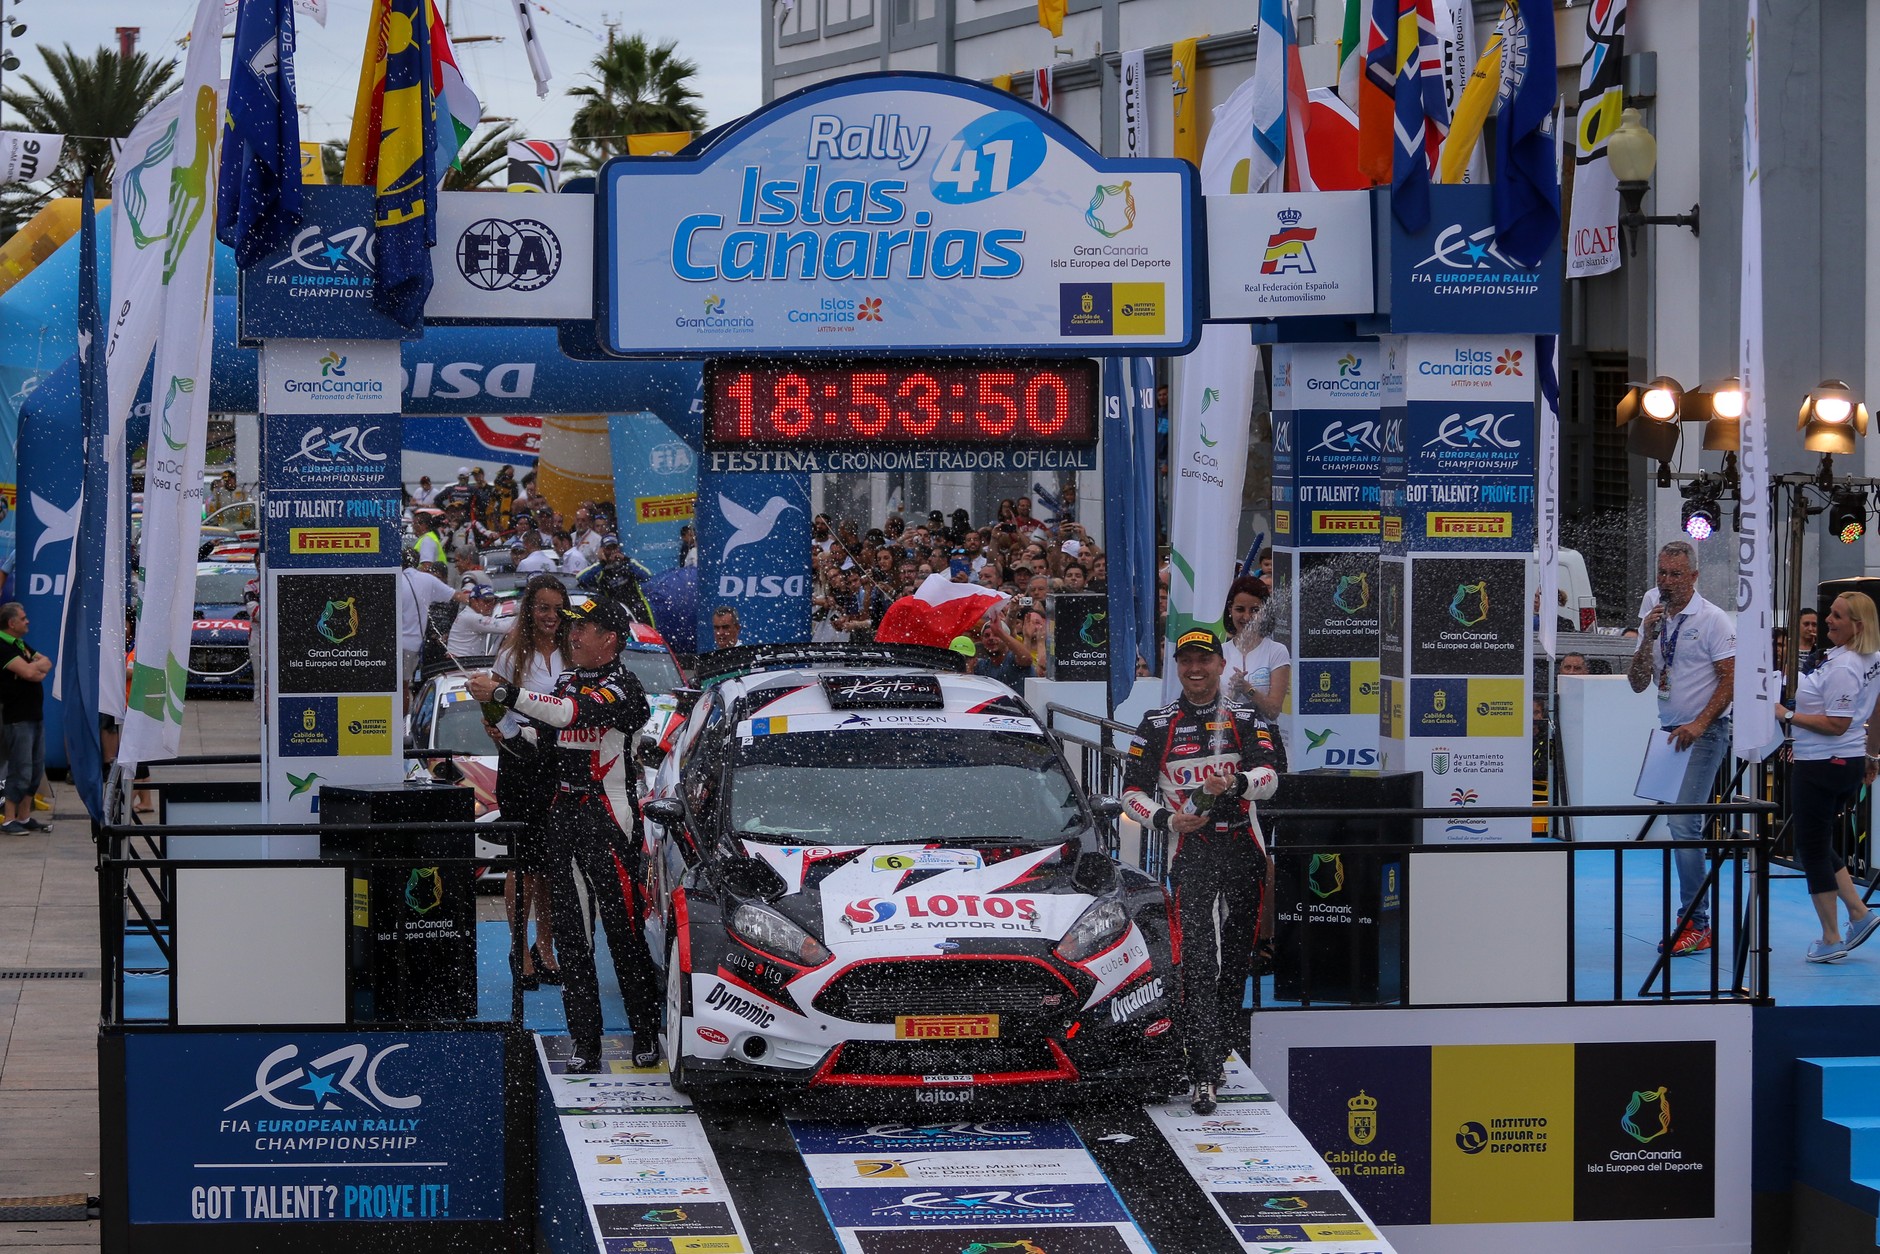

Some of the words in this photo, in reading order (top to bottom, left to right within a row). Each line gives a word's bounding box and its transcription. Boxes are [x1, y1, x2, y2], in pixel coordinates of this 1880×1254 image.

[808, 113, 931, 170] Rally
[932, 139, 1014, 193] 41
[737, 163, 907, 226] Islas
[671, 210, 1026, 281] Canarias
[1050, 258, 1067, 270] Isla
[1069, 258, 1110, 270] Europea
[1113, 258, 1129, 270] del
[1131, 258, 1171, 270] Deporte
[266, 275, 287, 285] FIA
[291, 276, 360, 286] EUROPEAN
[1411, 273, 1431, 283] FIA
[1435, 273, 1500, 283] EUROPEAN
[1503, 273, 1540, 283] RALLY
[1244, 283, 1260, 292] Real
[1262, 281, 1304, 292] Federación
[1305, 281, 1339, 292] Española
[1434, 285, 1538, 295] CHAMPIONSHIP
[820, 297, 855, 310] Islas
[1258, 293, 1267, 302] de
[1269, 293, 1326, 302] Automovilismo
[676, 315, 754, 328] GranCanaria
[788, 309, 855, 323] Canarias
[1455, 348, 1492, 362] Islas
[1419, 361, 1492, 376] Canarias
[284, 379, 383, 393] GranCanaria
[311, 393, 344, 401] Patronato
[346, 393, 354, 401] de
[356, 393, 383, 401] Turismo
[727, 373, 1069, 437] 18:53:50
[1422, 413, 1521, 449] ERC
[284, 426, 387, 462] ERC
[711, 451, 819, 472] FESTINA
[828, 450, 1005, 470] CRONOMETRADOR
[1012, 450, 1088, 468] OFICIAL
[1420, 451, 1436, 459] FIA
[1439, 451, 1489, 459] EUROPEAN
[1491, 451, 1519, 459] RALLY
[282, 465, 298, 473] FIA
[302, 465, 354, 473] EUROPEAN
[356, 465, 386, 473] RALLY
[1438, 460, 1518, 468] CHAMPIONSHIP
[300, 474, 385, 482] CHAMPIONSHIP
[1407, 485, 1429, 502] GOT
[1432, 485, 1479, 502] TALENT?
[1481, 485, 1516, 502] PROVE
[1518, 485, 1534, 502] IT!
[268, 500, 293, 518] GOT
[294, 500, 344, 518] TALENT?
[346, 500, 382, 518] PROVE
[1435, 516, 1504, 533] PIRELLI
[299, 532, 371, 549] PIRELLI
[1422, 641, 1435, 651] Isla
[1437, 641, 1467, 651] Europea
[1470, 641, 1482, 651] del
[1484, 641, 1515, 651] Deporte
[290, 658, 303, 668] Isla
[305, 658, 338, 668] Europea
[339, 658, 352, 668] del
[354, 658, 386, 668] Deporte
[538, 695, 563, 706] LOTOS
[879, 715, 947, 723] LOPESAN
[560, 728, 596, 743] LOTOS
[1453, 753, 1504, 761] Ayuntamiento
[887, 856, 902, 869] 6
[905, 895, 1036, 921] LOTOS
[850, 923, 906, 935] FUELS
[910, 922, 924, 931] &
[928, 920, 996, 930] MOTOR
[1002, 923, 1041, 933] OILS
[726, 950, 755, 972] cube
[1101, 957, 1124, 976] cube
[705, 982, 776, 1030] Dynamic
[1110, 977, 1164, 1023] Dynamic
[905, 1017, 990, 1037] PIRELLI
[223, 1043, 422, 1112] ERC
[915, 1087, 974, 1103] kajto.pl
[220, 1120, 251, 1133] FIA
[257, 1119, 359, 1132] EUROPEAN
[362, 1119, 420, 1131] RALLY
[1491, 1117, 1547, 1128] INSTITUTO
[1491, 1130, 1534, 1141] INSULAR
[1536, 1132, 1547, 1140] DE
[255, 1137, 417, 1150] CHAMPIONSHIP
[1491, 1143, 1547, 1154] DEPORTES
[1324, 1150, 1375, 1164] Cabildo
[1379, 1150, 1396, 1164] de
[986, 1162, 1061, 1170] Municipal
[1330, 1163, 1350, 1176] ran
[1353, 1163, 1405, 1176] Canaria
[1587, 1163, 1603, 1173] Isla
[1605, 1162, 1645, 1174] Europea
[1647, 1162, 1662, 1172] del
[1664, 1161, 1703, 1173] Deporte
[191, 1186, 235, 1220] GOT
[241, 1185, 338, 1219] TALENT?
[344, 1184, 414, 1218] PROVE
[420, 1184, 449, 1217] IT!
